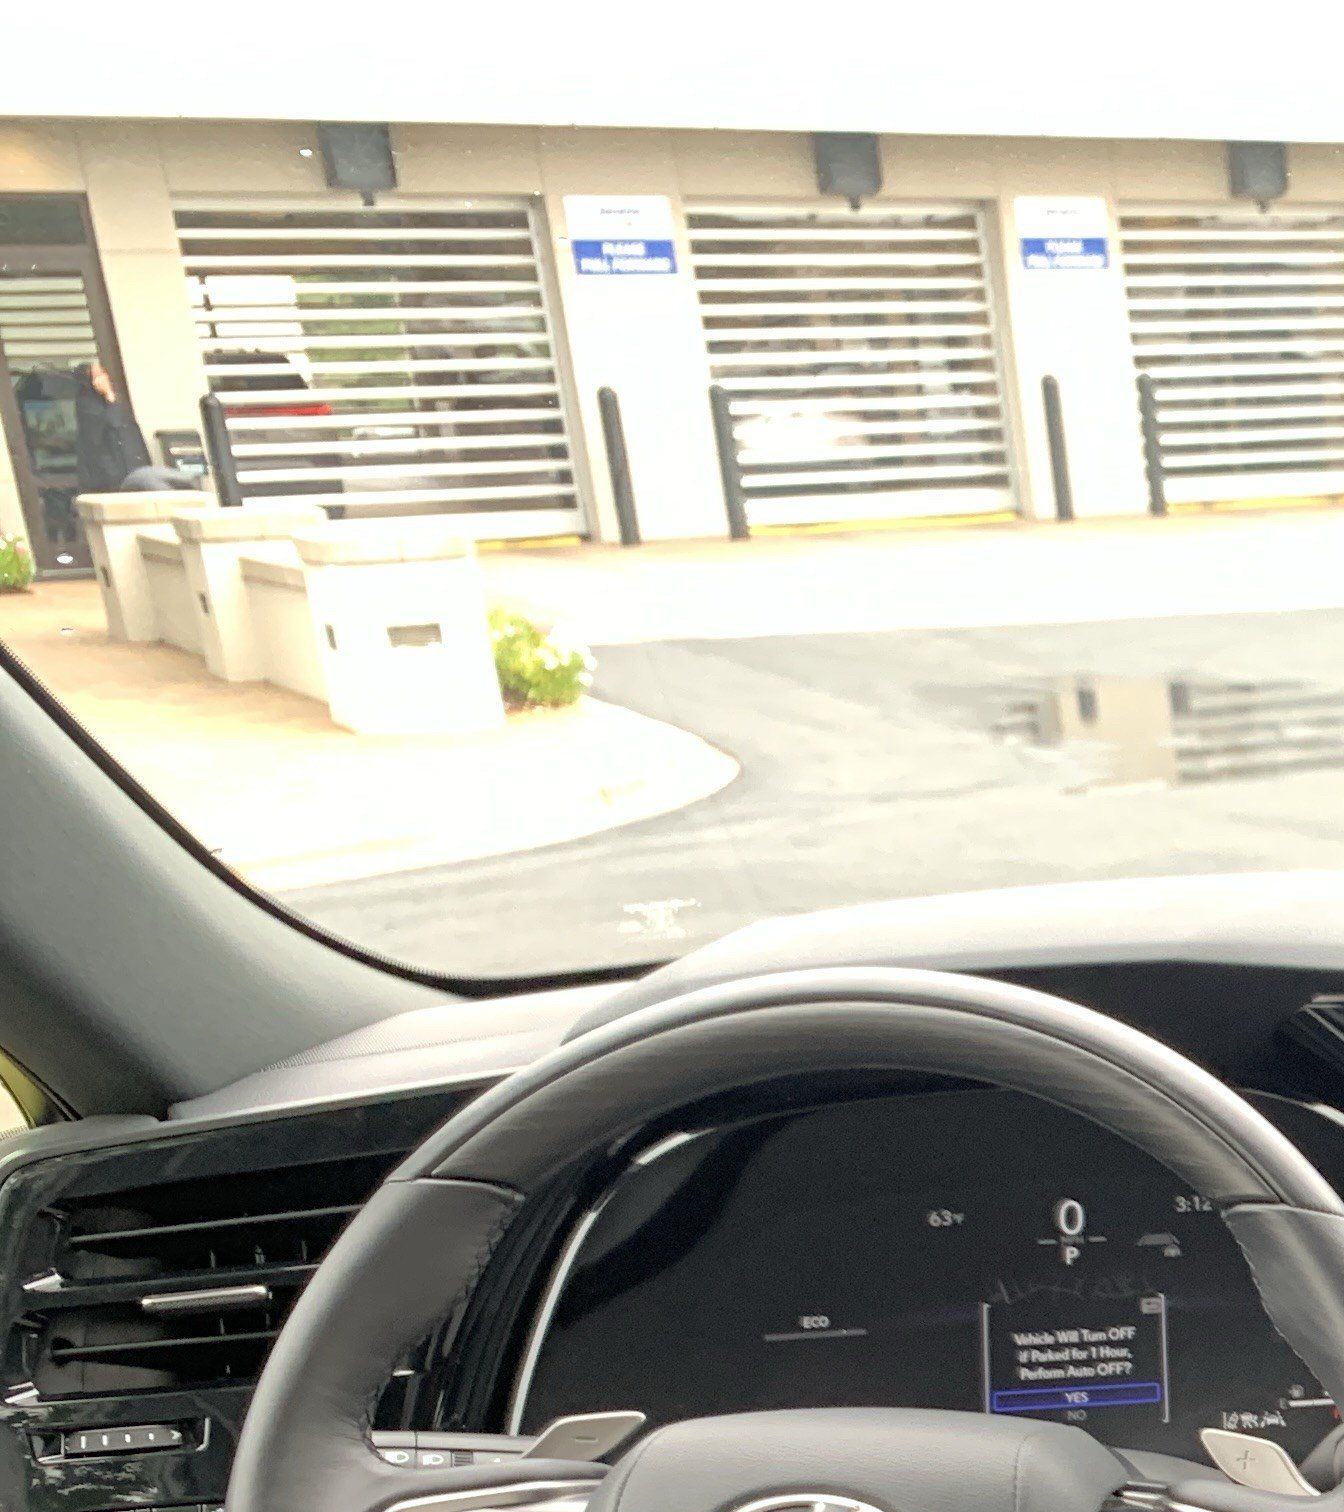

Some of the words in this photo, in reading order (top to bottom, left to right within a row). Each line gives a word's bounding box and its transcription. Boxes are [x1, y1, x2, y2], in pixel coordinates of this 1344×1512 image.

[1175, 1195, 1212, 1213] 3:12
[1059, 1199, 1084, 1236] 0
[1065, 1246, 1080, 1265] P
[801, 1315, 830, 1329] ECO
[1013, 1331, 1055, 1346] Vehicle
[1080, 1328, 1107, 1342] Turn
[1108, 1325, 1137, 1340] OFF
[1031, 1348, 1070, 1363] Parked
[1072, 1347, 1089, 1360] for
[1020, 1366, 1065, 1381] Perform
[1067, 1364, 1095, 1378] Auto
[1096, 1361, 1133, 1377] OFF?
[1065, 1391, 1089, 1403] YES
